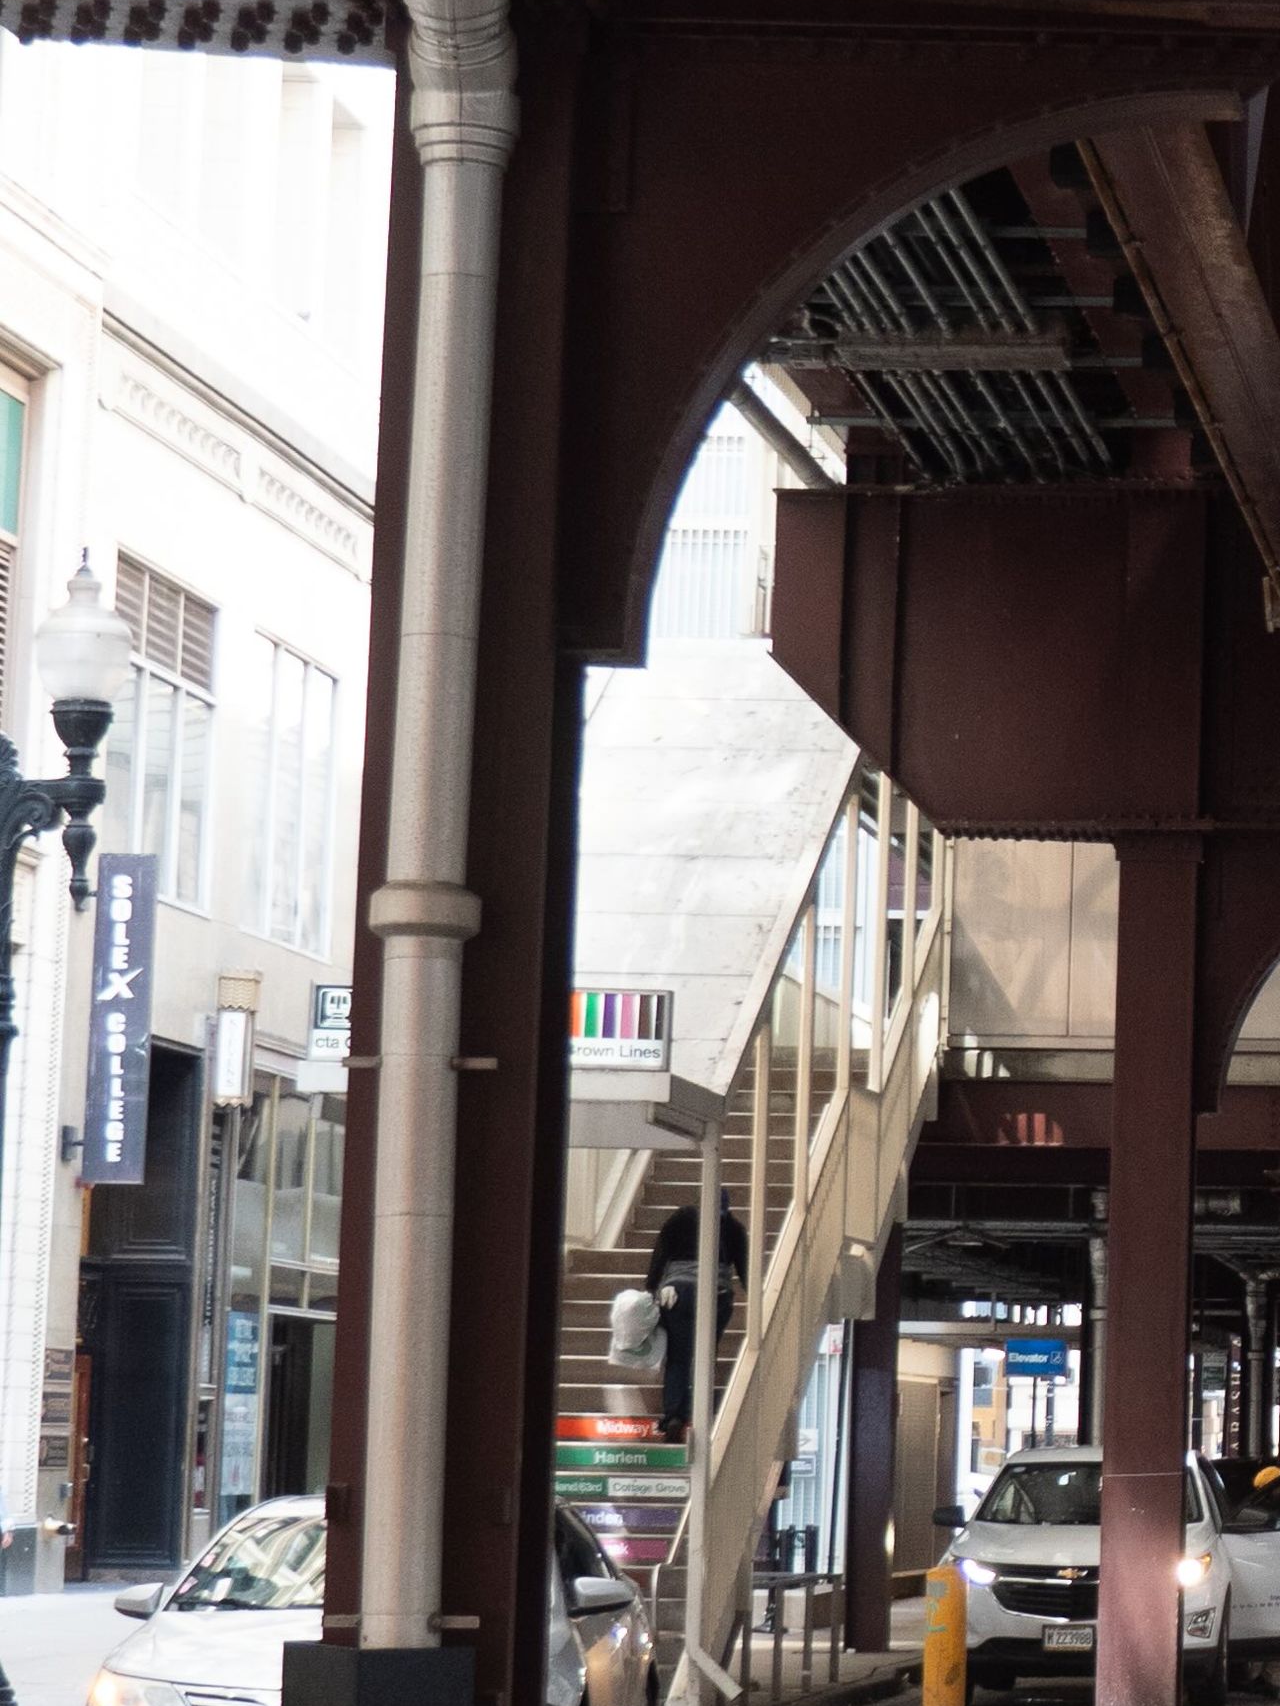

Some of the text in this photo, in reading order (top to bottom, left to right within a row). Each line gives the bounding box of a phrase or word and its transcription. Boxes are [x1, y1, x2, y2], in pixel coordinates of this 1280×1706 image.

[97, 874, 144, 1000] SOLEX
[315, 1036, 340, 1049] cta
[576, 1044, 661, 1059] rown Lines
[106, 1012, 127, 1162] COLLEGE
[1008, 1352, 1049, 1364] Elevator
[596, 1418, 650, 1436] Midway
[594, 1451, 648, 1465] Harlem
[612, 1482, 687, 1494] Cottage Grove
[582, 1511, 624, 1525] inden
